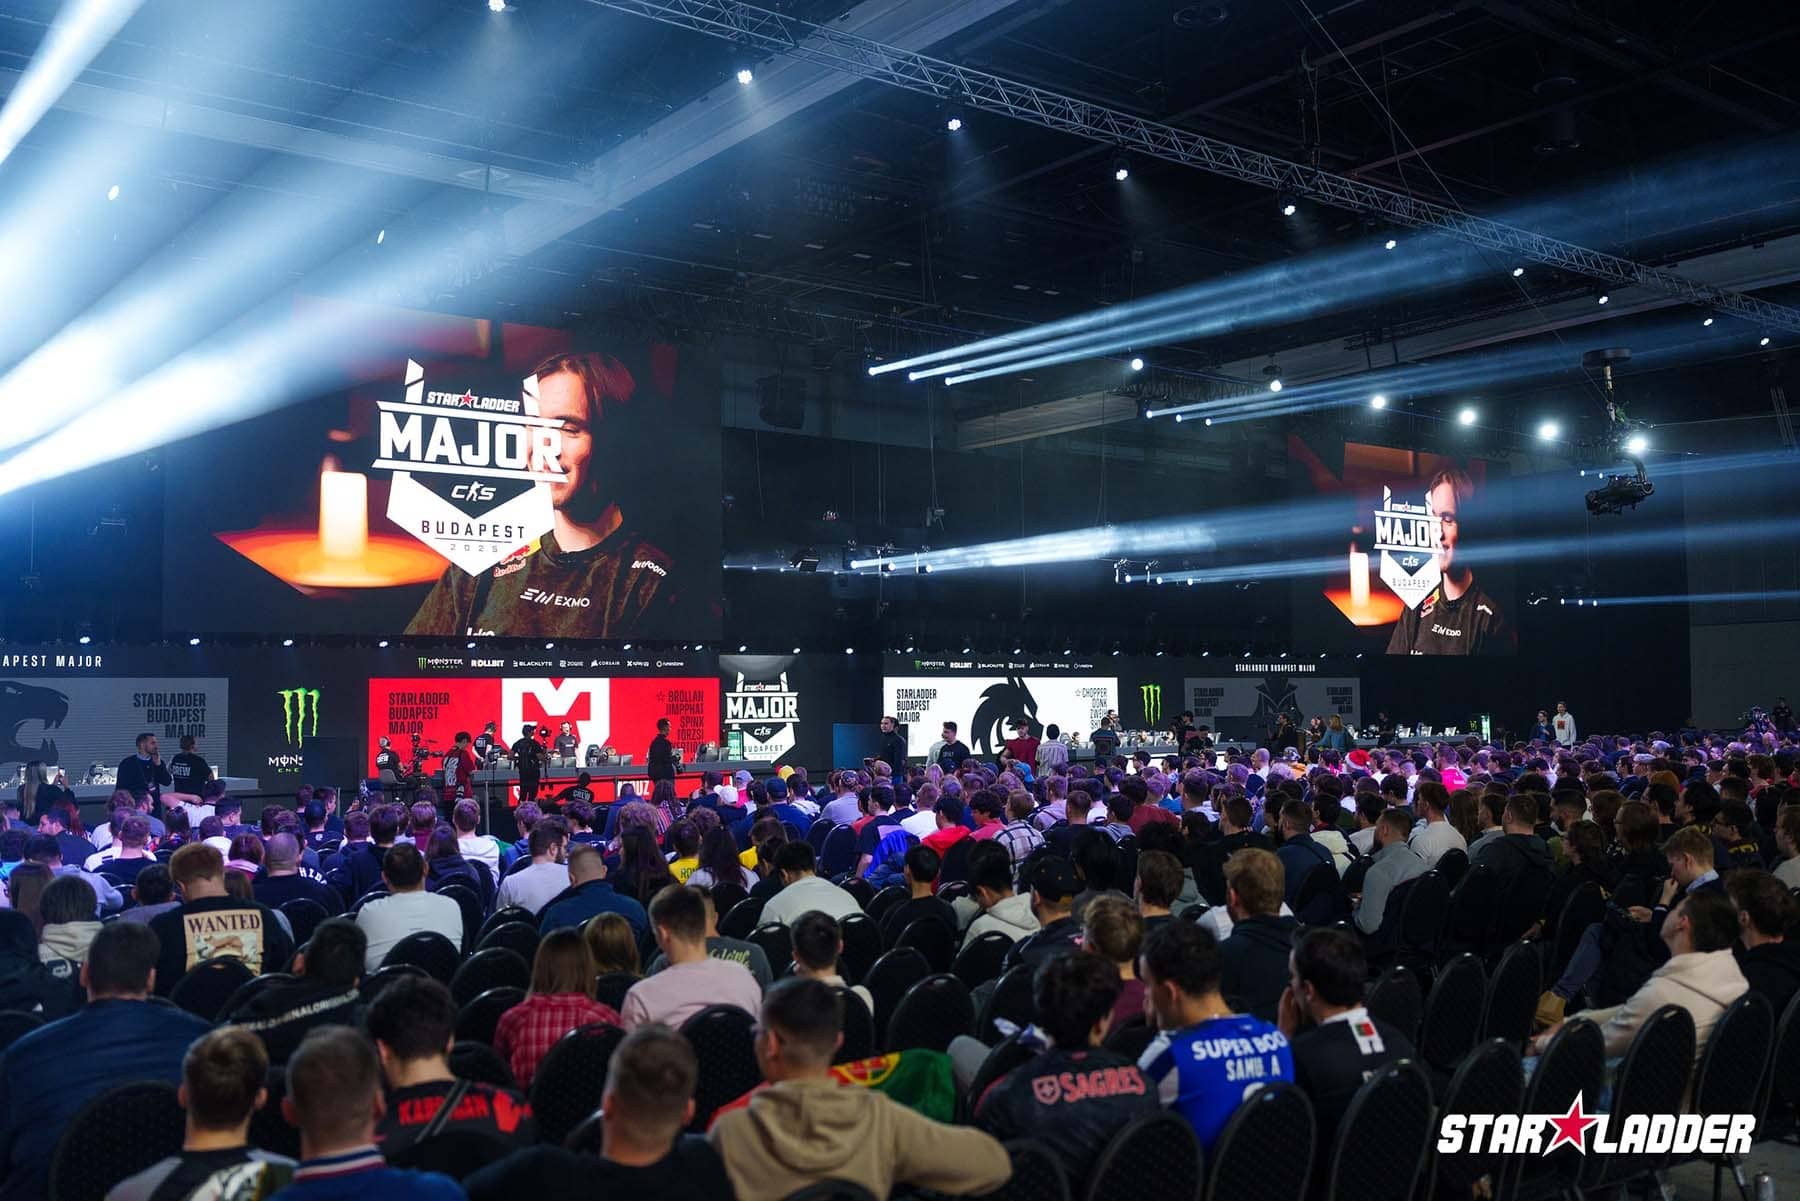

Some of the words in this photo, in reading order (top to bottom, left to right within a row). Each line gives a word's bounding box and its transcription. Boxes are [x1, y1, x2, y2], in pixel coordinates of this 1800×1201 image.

[380, 411, 565, 474] MAJOR
[421, 519, 525, 539] BUDAPEST
[1375, 516, 1443, 549] MAJOR
[450, 543, 498, 553] 2025
[554, 595, 591, 608] EXMO
[2, 655, 47, 667] APEST
[55, 655, 102, 667] MAJOR
[471, 659, 504, 667] ROLLBIT
[133, 692, 206, 707] STARLADDER
[389, 692, 450, 705] STARLADDER
[668, 689, 704, 702] BROLLAN
[896, 688, 937, 700] STARLADDER
[727, 696, 798, 719] MAJOR
[896, 700, 930, 711] BUDAPEST
[146, 708, 207, 723] BUDAPEST
[389, 706, 439, 720] BUDAPEST
[896, 711, 921, 722] MAJOR
[165, 723, 206, 738] MAJOR
[389, 720, 424, 734] MAJOR
[188, 913, 261, 934] WANTED
[1191, 1038, 1255, 1061] SUPER
[1059, 1064, 1145, 1103] SAGRES
